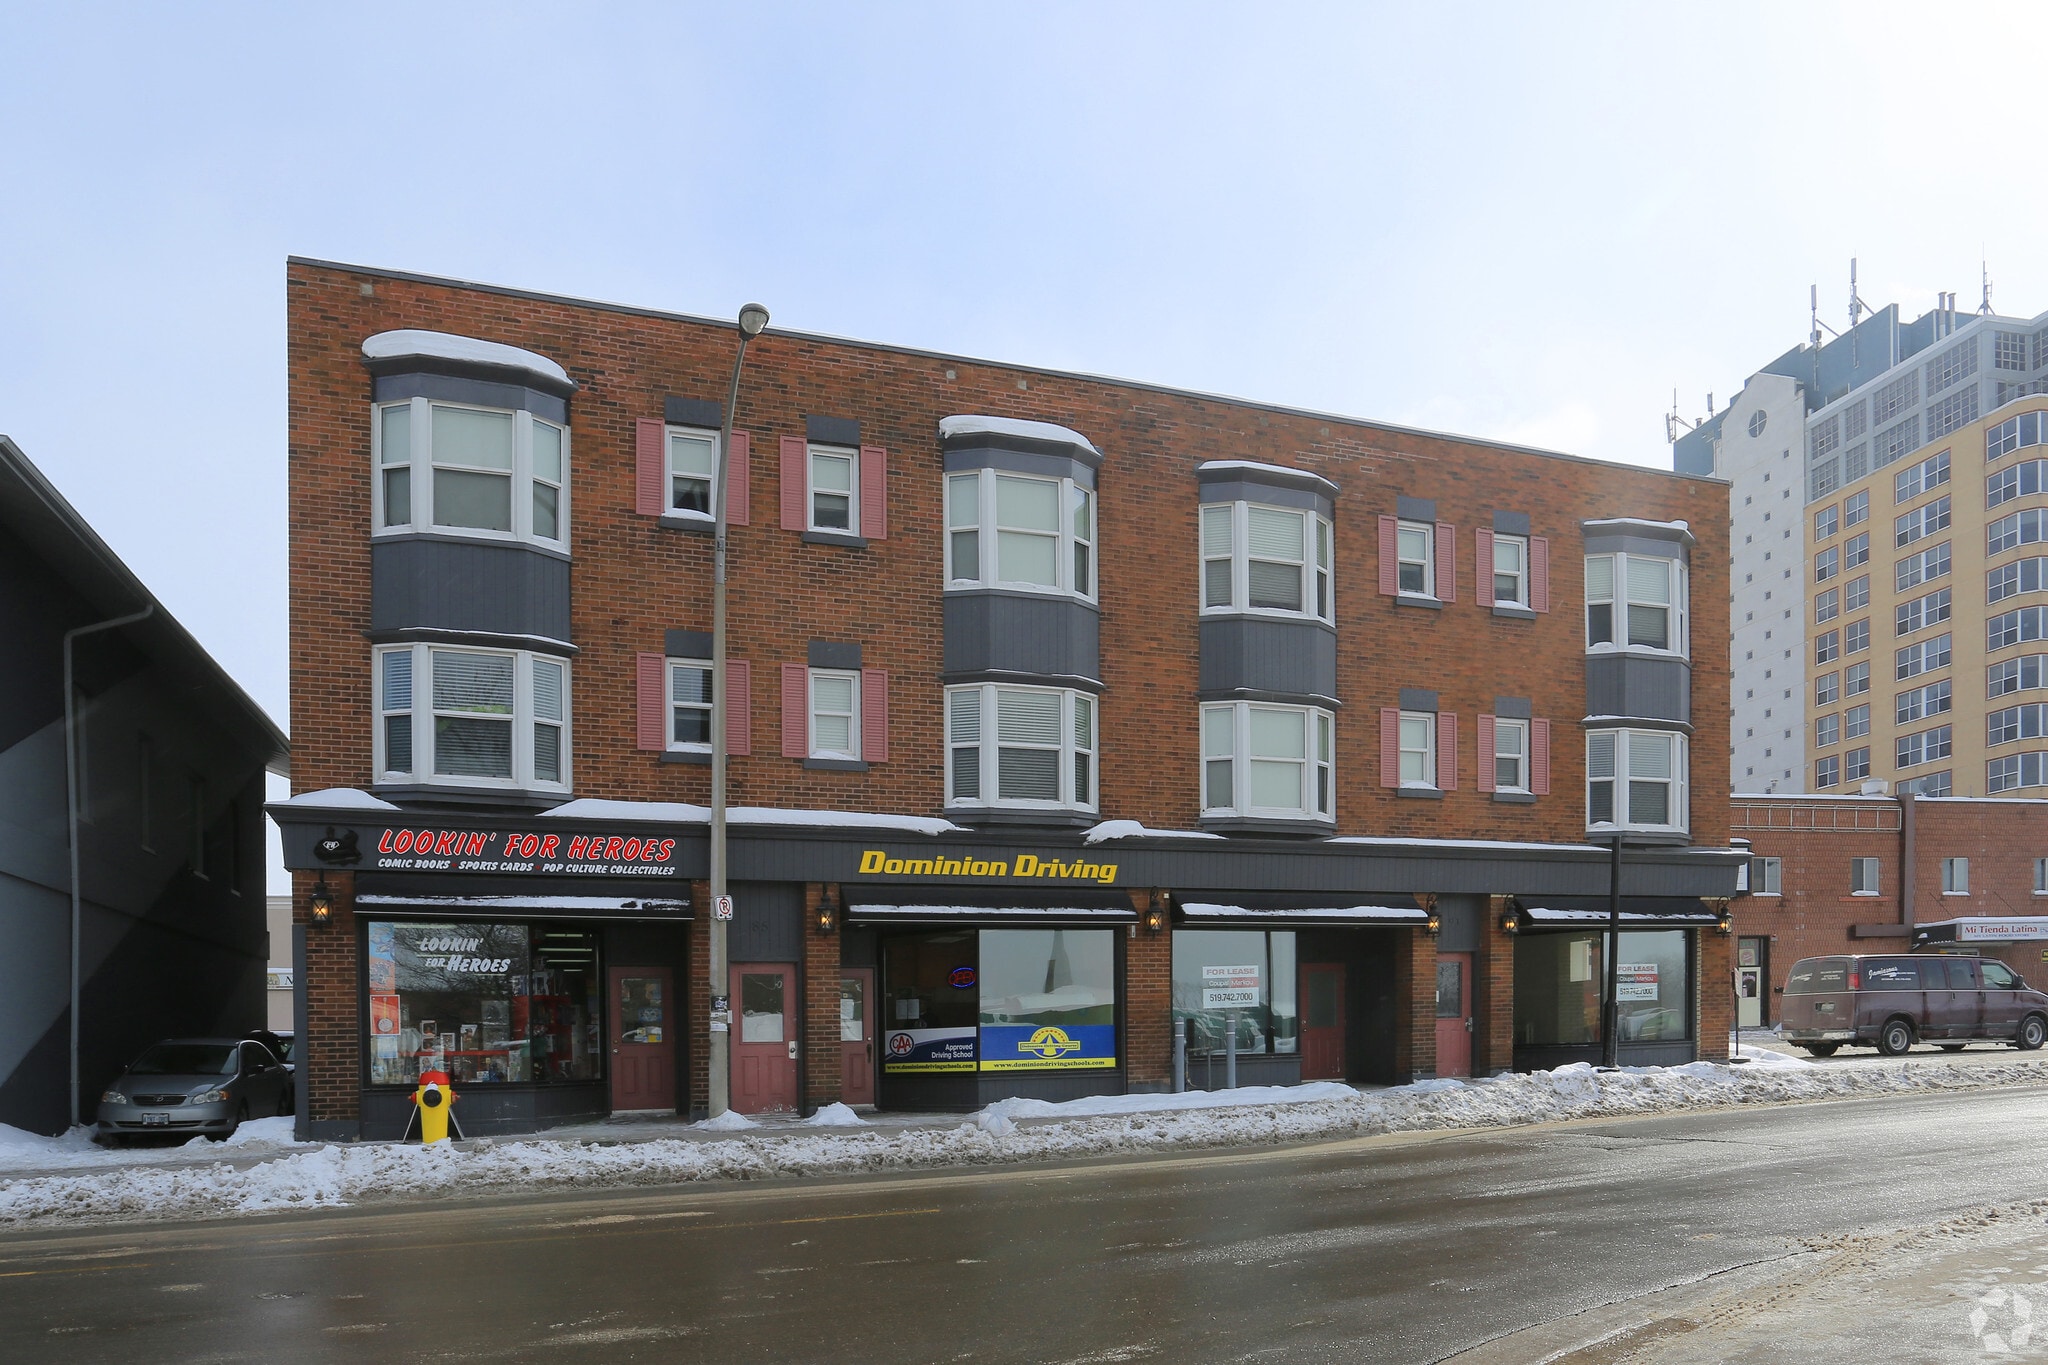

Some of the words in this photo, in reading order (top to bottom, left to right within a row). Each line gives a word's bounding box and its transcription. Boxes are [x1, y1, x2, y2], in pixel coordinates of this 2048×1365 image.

[378, 829, 497, 856] LOOKIN'
[503, 833, 560, 859] FOR
[567, 835, 676, 862] HEROES
[378, 859, 413, 868] COMIC
[414, 860, 451, 870] BOOKS
[458, 860, 498, 871] SPORTS
[500, 862, 534, 872] CARDS
[542, 863, 564, 873] POP
[565, 864, 609, 874] CULTURE
[610, 865, 676, 876] COLLECTIBLES
[858, 850, 1008, 876] Dominion
[1012, 854, 1118, 884] Driving
[420, 937, 484, 952] LOOKIN'
[425, 958, 446, 967] FOR
[1209, 993, 1253, 1001] 519.742.7000
[892, 1035, 912, 1053] CAA
[945, 1043, 973, 1052] Approved
[993, 1061, 1105, 1069] www.dominiondrivingschools.com
